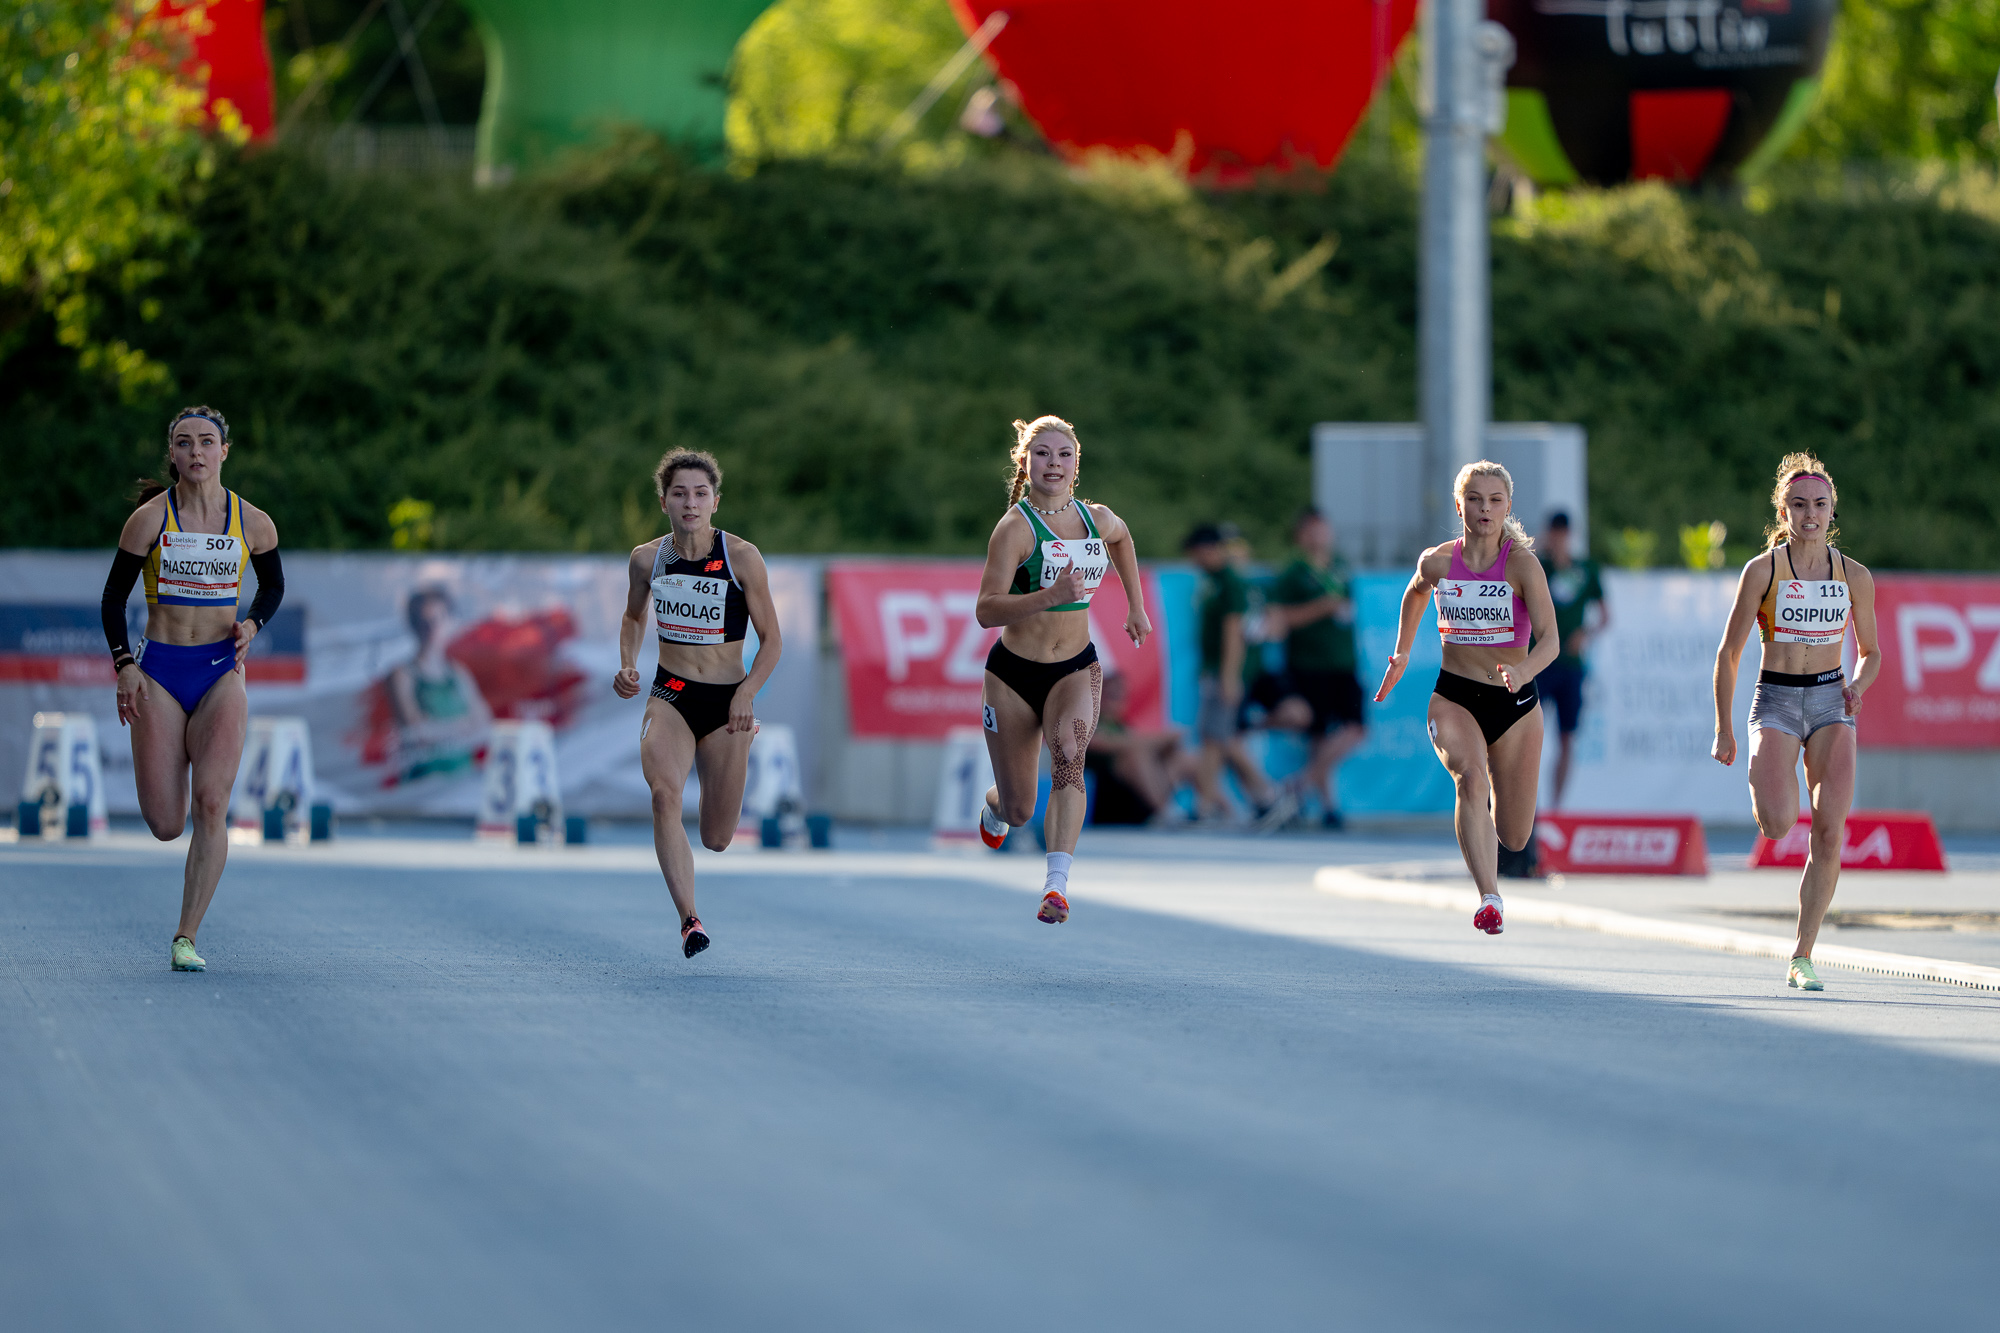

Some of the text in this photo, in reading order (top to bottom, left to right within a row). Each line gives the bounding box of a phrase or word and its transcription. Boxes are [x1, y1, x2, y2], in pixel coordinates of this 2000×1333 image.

[205, 537, 235, 551] 507
[1084, 542, 1101, 556] 98
[163, 559, 237, 576] PIASZCZYŃSKA
[178, 588, 201, 596] LUBLIN
[692, 580, 719, 596] 461
[1479, 584, 1507, 598] 226
[655, 598, 720, 623] ZIMOLĄG
[1440, 606, 1511, 621] KWASIBORSKA
[1781, 607, 1846, 623] OSIPIUK
[667, 631, 688, 640] LUBLIN
[1794, 636, 1816, 644] LUBLIN
[1817, 671, 1837, 683] NIKE
[984, 705, 993, 729] 3
